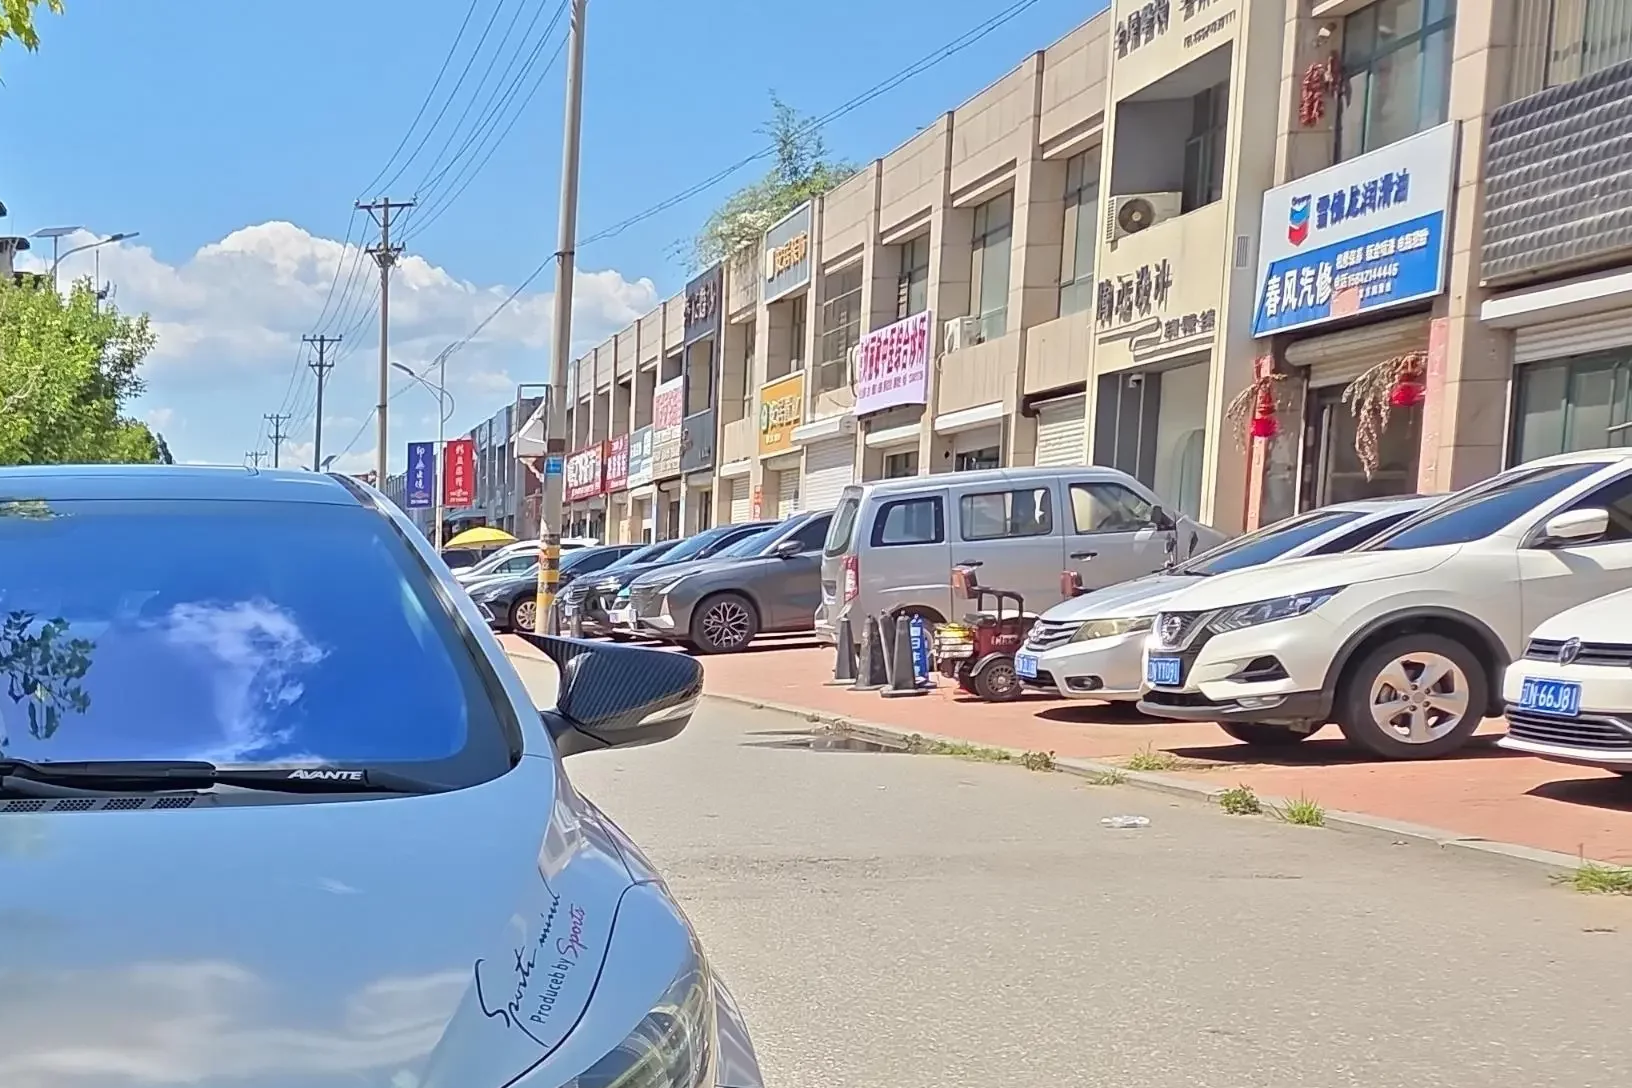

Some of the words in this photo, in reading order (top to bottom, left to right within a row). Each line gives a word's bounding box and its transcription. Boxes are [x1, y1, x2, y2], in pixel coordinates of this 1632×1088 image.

[1316, 168, 1410, 230] 雪佛龙润滑油
[1265, 261, 1334, 317] 春风汽修
[287, 769, 364, 780] AVANTE
[556, 903, 588, 959] Sports
[552, 957, 576, 972] by
